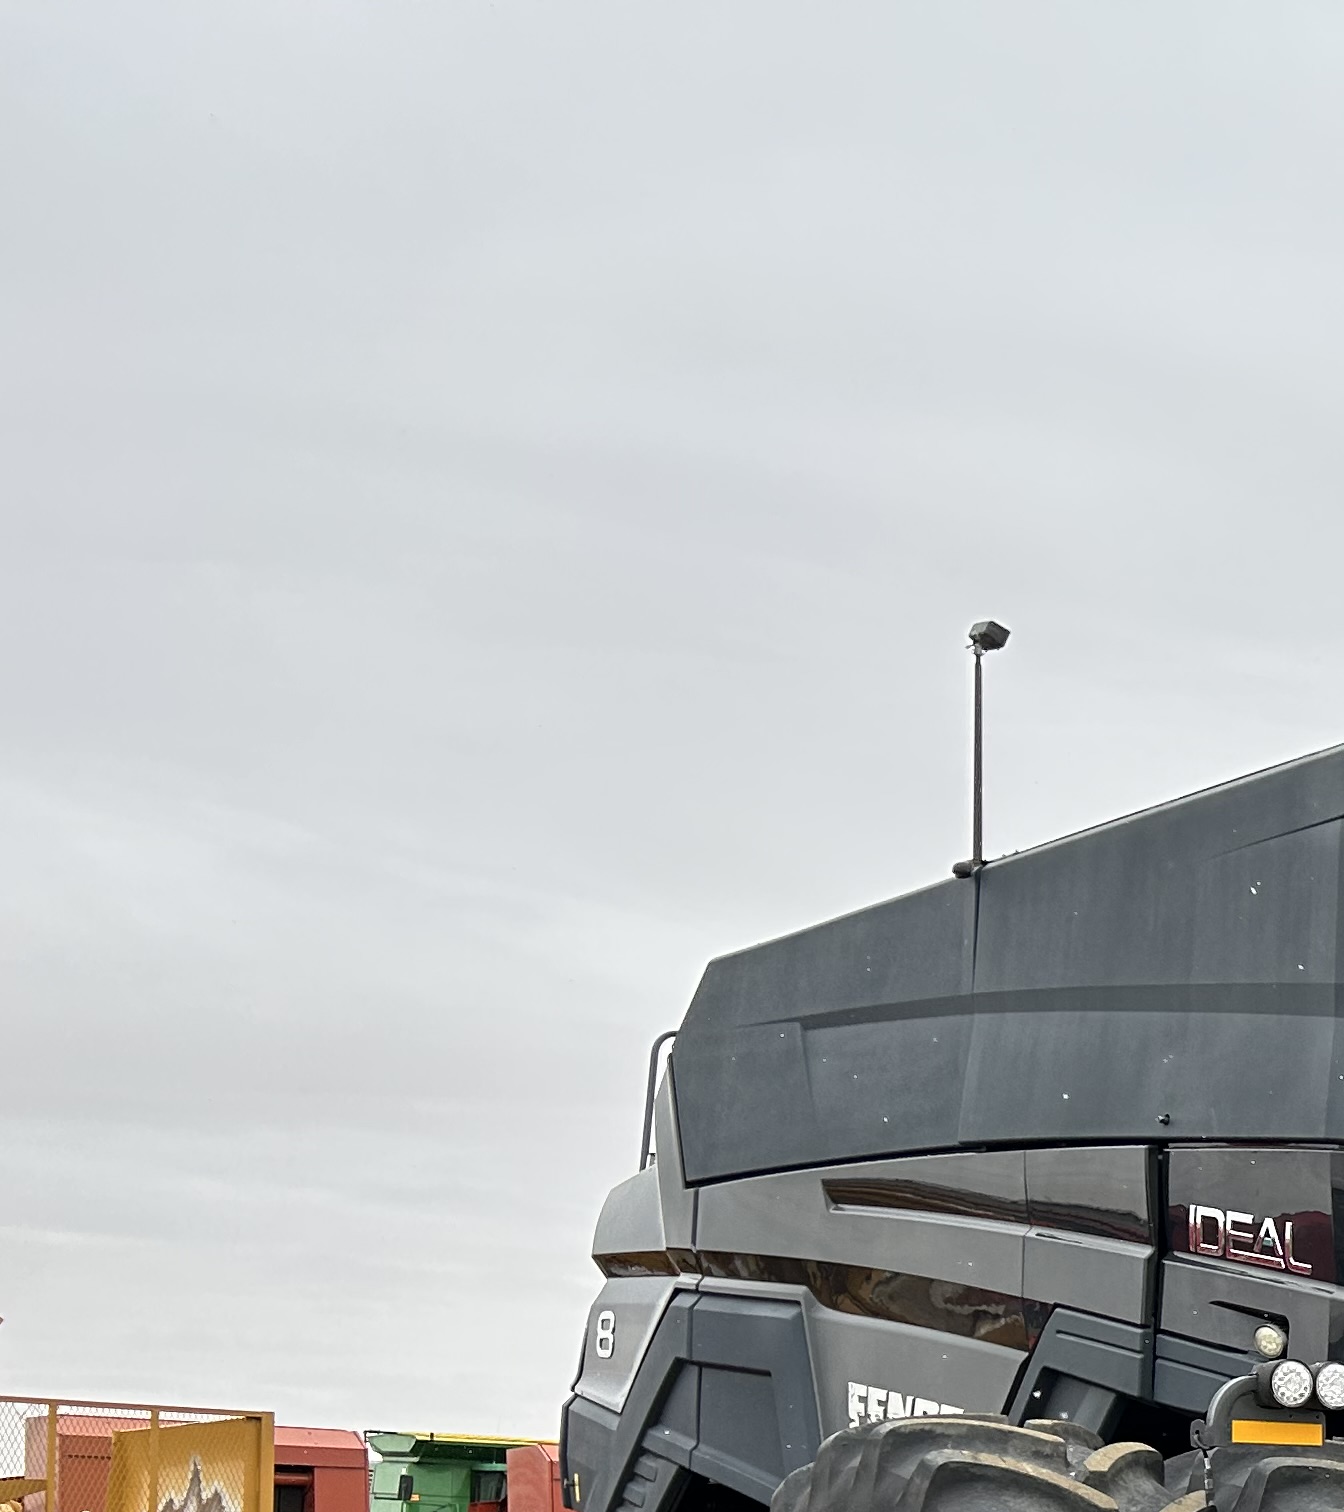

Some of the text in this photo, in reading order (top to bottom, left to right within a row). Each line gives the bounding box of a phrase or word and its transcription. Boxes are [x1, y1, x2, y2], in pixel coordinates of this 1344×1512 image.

[1189, 1204, 1313, 1276] IDEAL
[596, 1310, 616, 1359] 8
[847, 1381, 965, 1428] FEN
